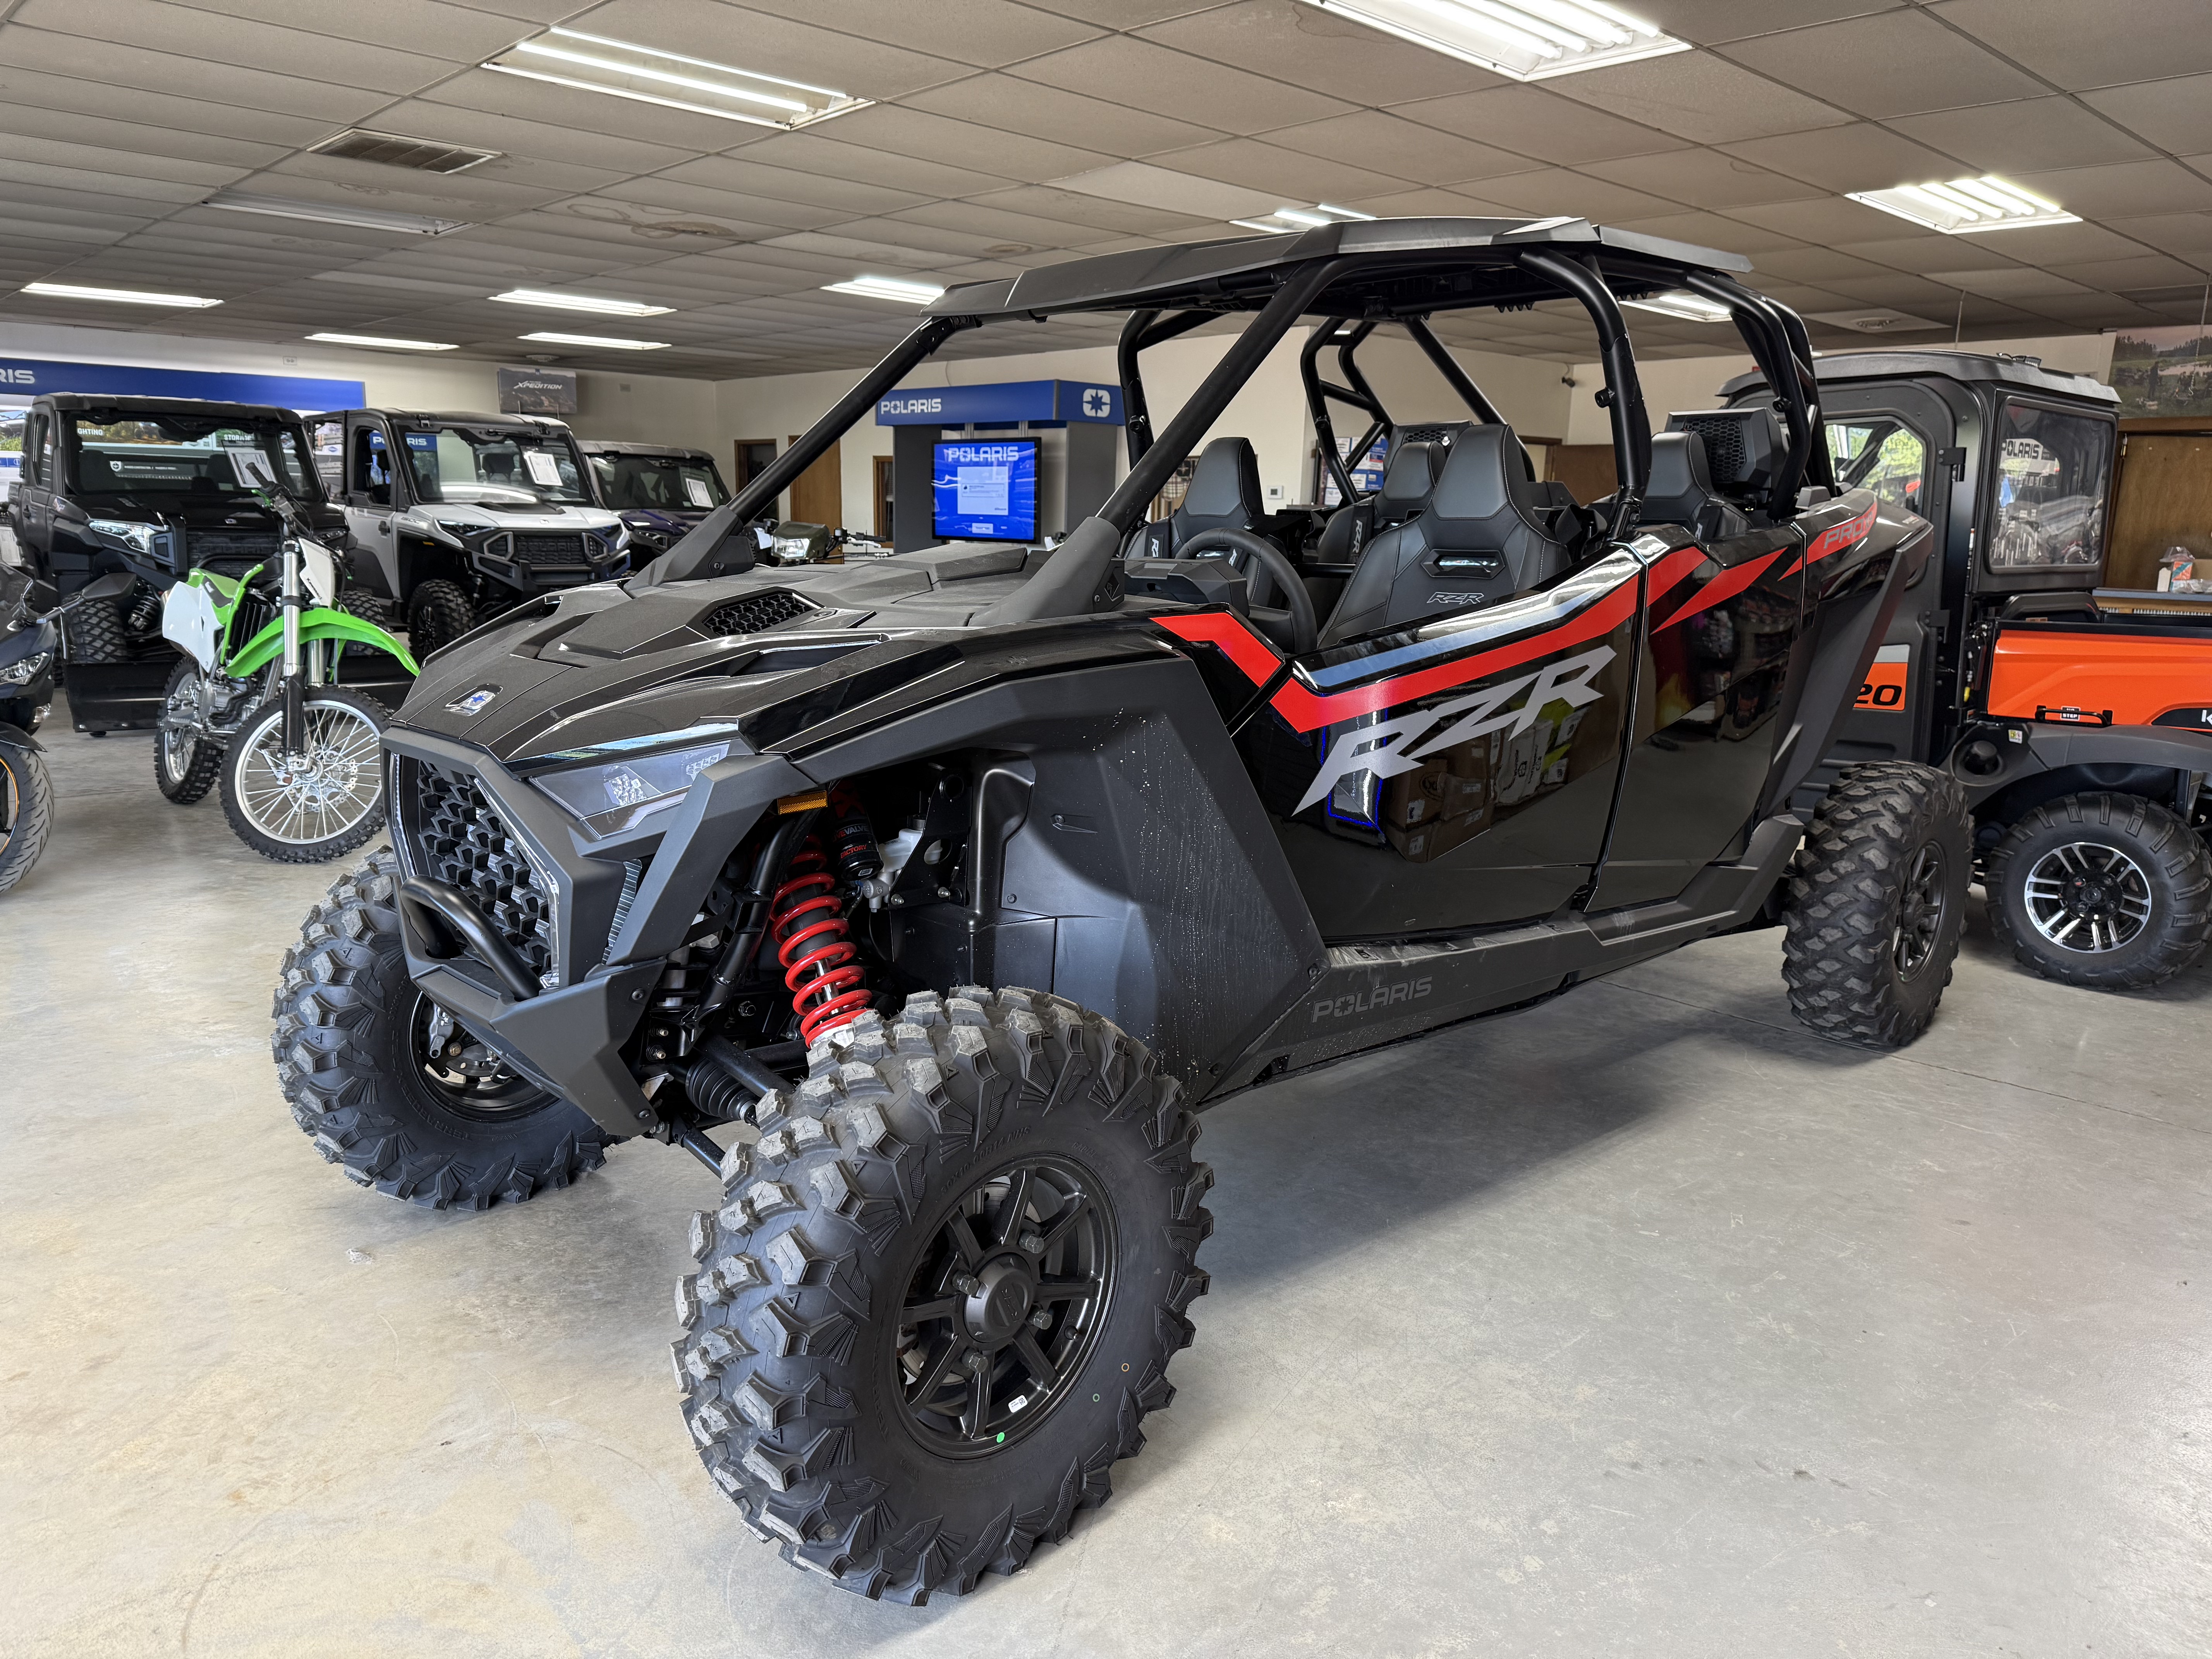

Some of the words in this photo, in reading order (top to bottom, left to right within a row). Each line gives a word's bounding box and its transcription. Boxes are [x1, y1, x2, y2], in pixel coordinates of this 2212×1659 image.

[514, 381, 562, 390] XPEDITION
[881, 398, 942, 414] POLARIS
[948, 447, 1019, 462] POLARIS
[1352, 520, 1363, 553] RZR
[1427, 592, 1484, 605] RZR
[1291, 645, 1617, 817] RZR
[840, 844, 867, 859] FACTORY
[1311, 975, 1432, 1024] POLARIS
